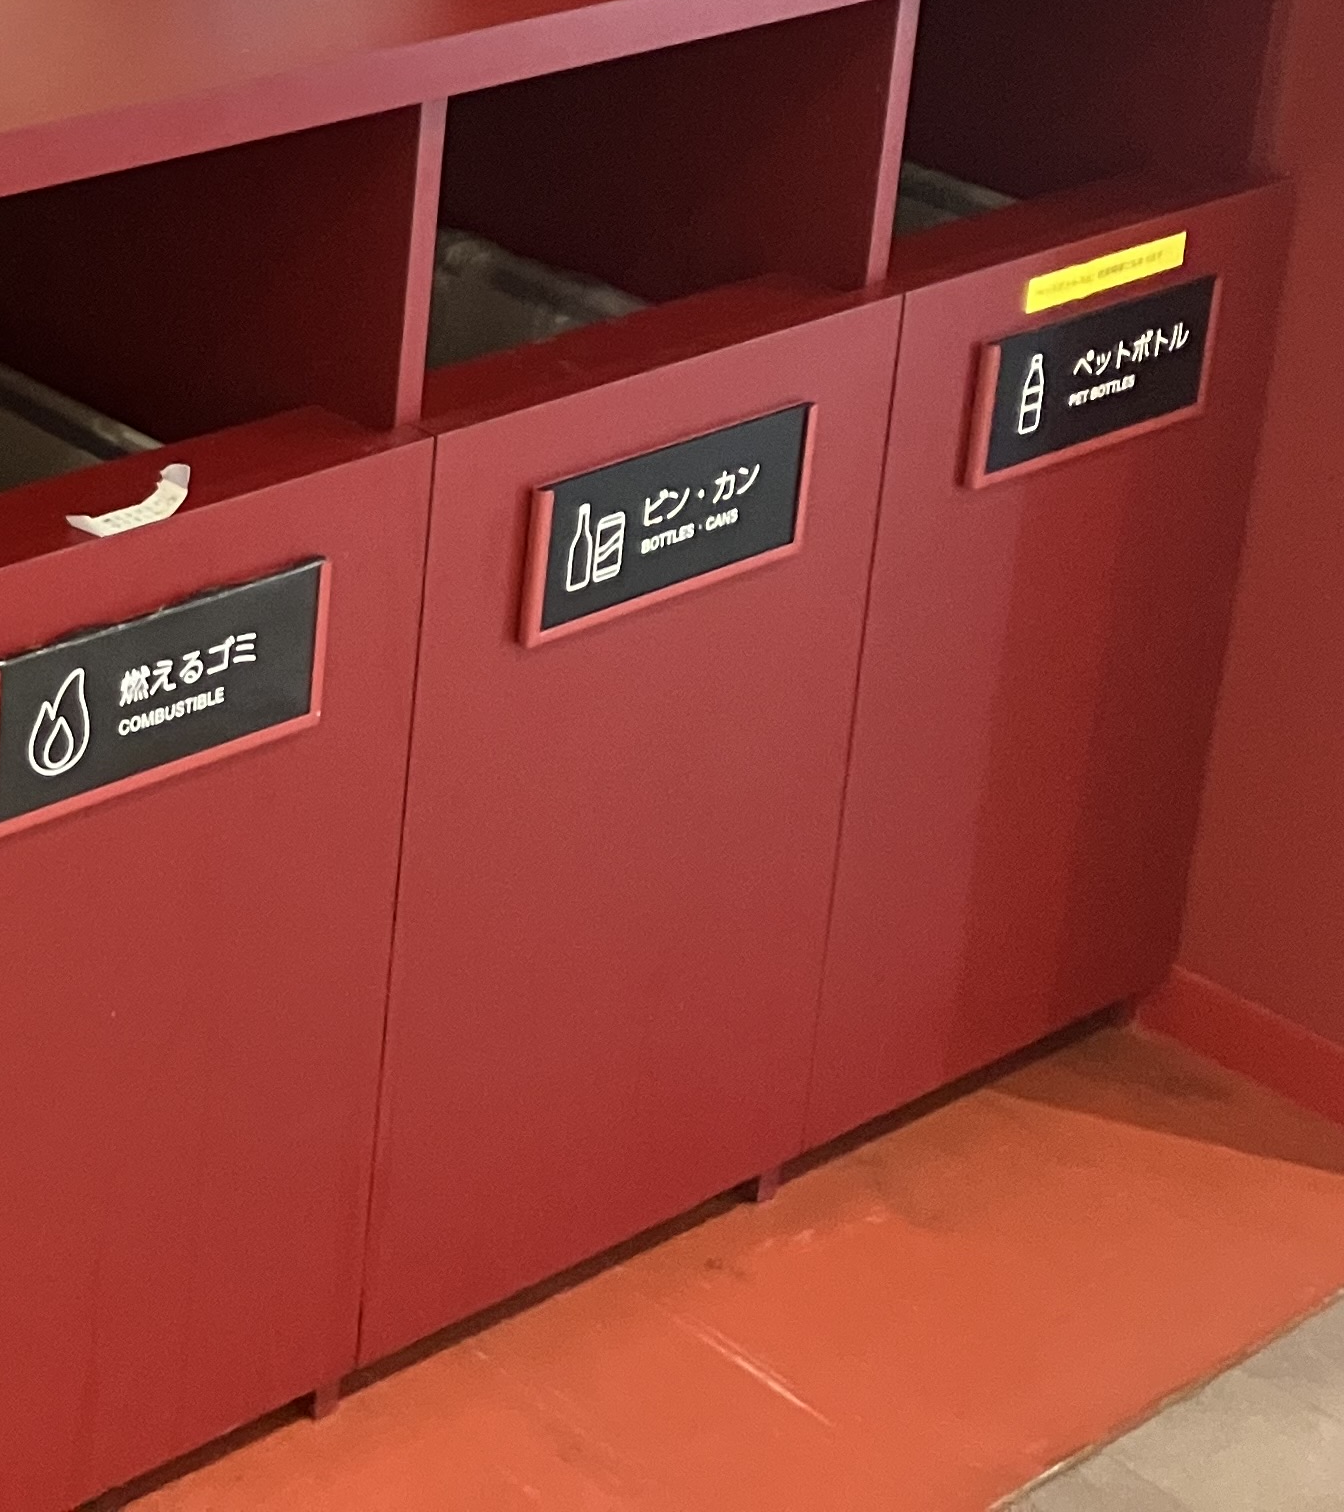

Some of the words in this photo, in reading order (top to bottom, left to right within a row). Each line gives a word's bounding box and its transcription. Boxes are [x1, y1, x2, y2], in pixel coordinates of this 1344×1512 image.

[1072, 322, 1190, 376] ペットボトル
[1068, 385, 1089, 407] PET
[1089, 374, 1136, 400] BOTTLES
[640, 522, 695, 555] BOTTLES
[705, 507, 739, 532] CANS
[118, 631, 257, 707] 燃えるゴミ
[117, 686, 226, 737] COMBUSTIBLE
